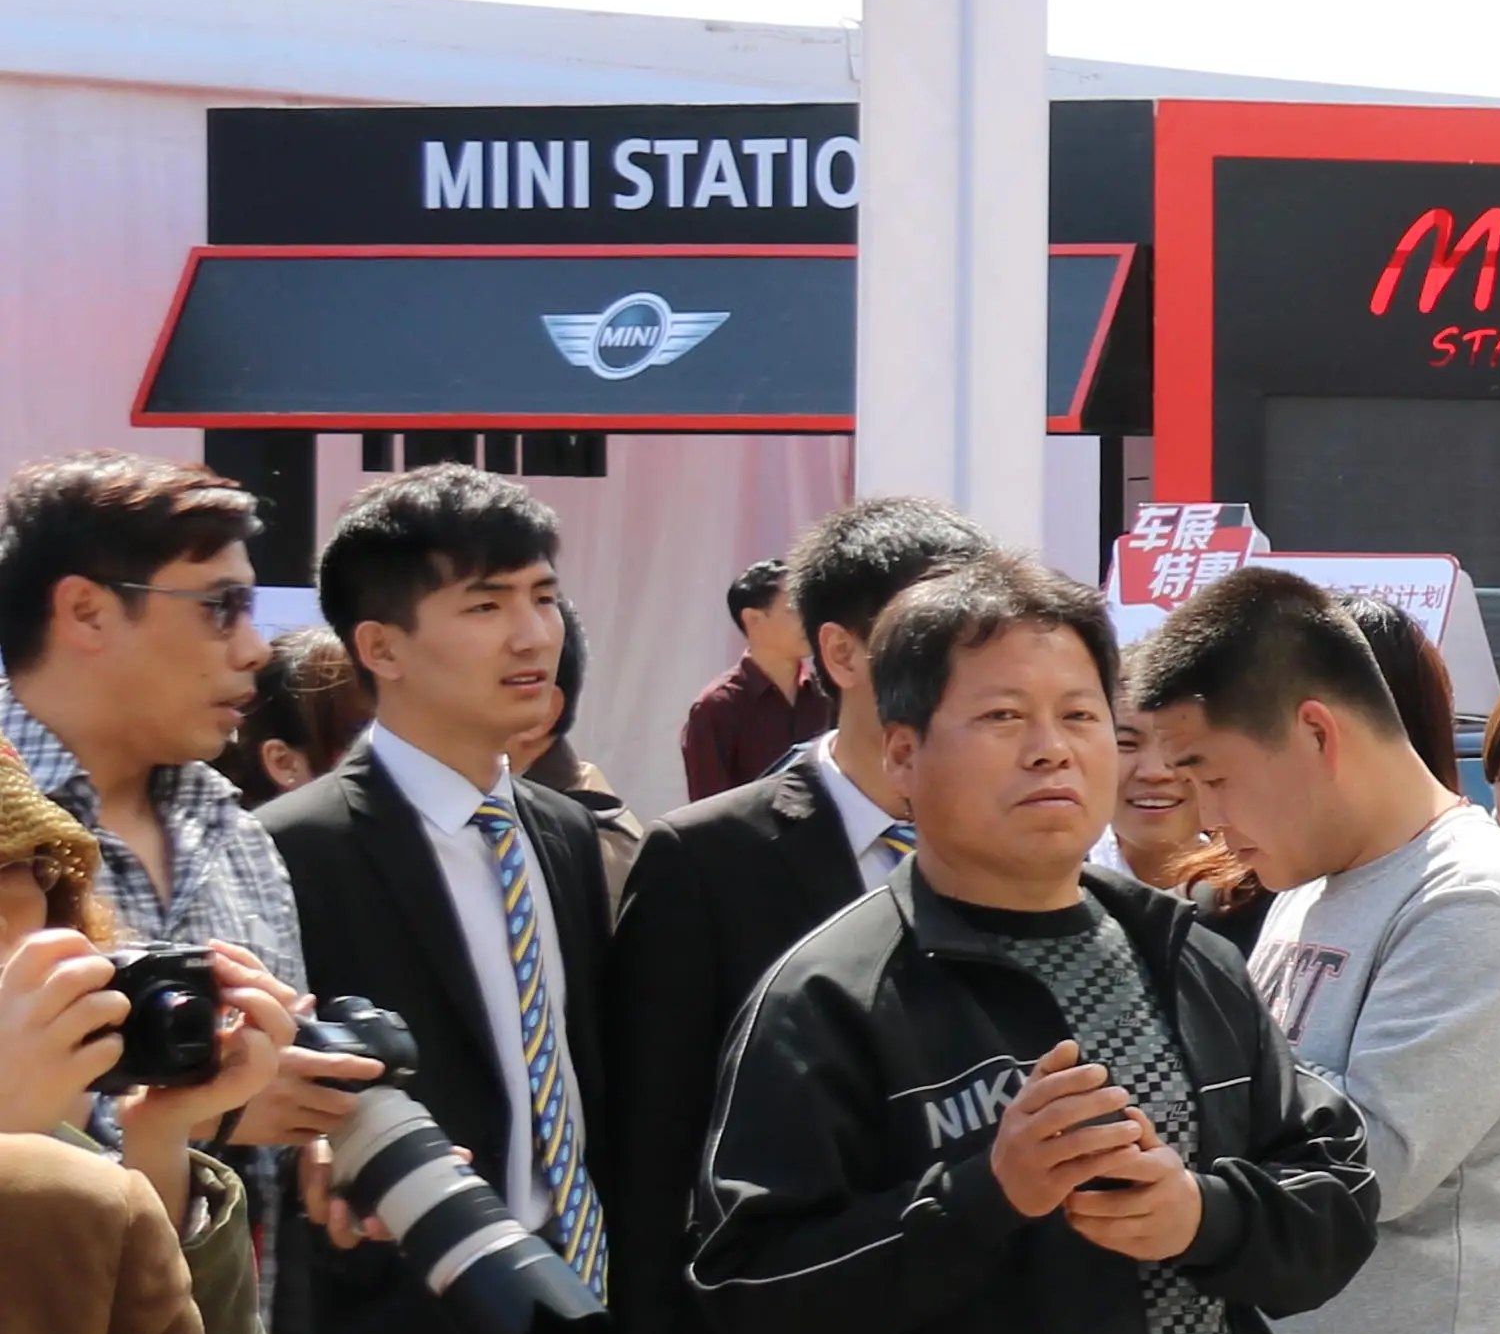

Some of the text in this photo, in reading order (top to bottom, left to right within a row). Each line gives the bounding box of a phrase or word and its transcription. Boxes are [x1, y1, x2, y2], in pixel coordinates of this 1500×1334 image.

[423, 135, 858, 210] MINI STATIO
[601, 324, 660, 349] MINI
[1129, 503, 1221, 553] 车展
[924, 1068, 1030, 1149] NIK
